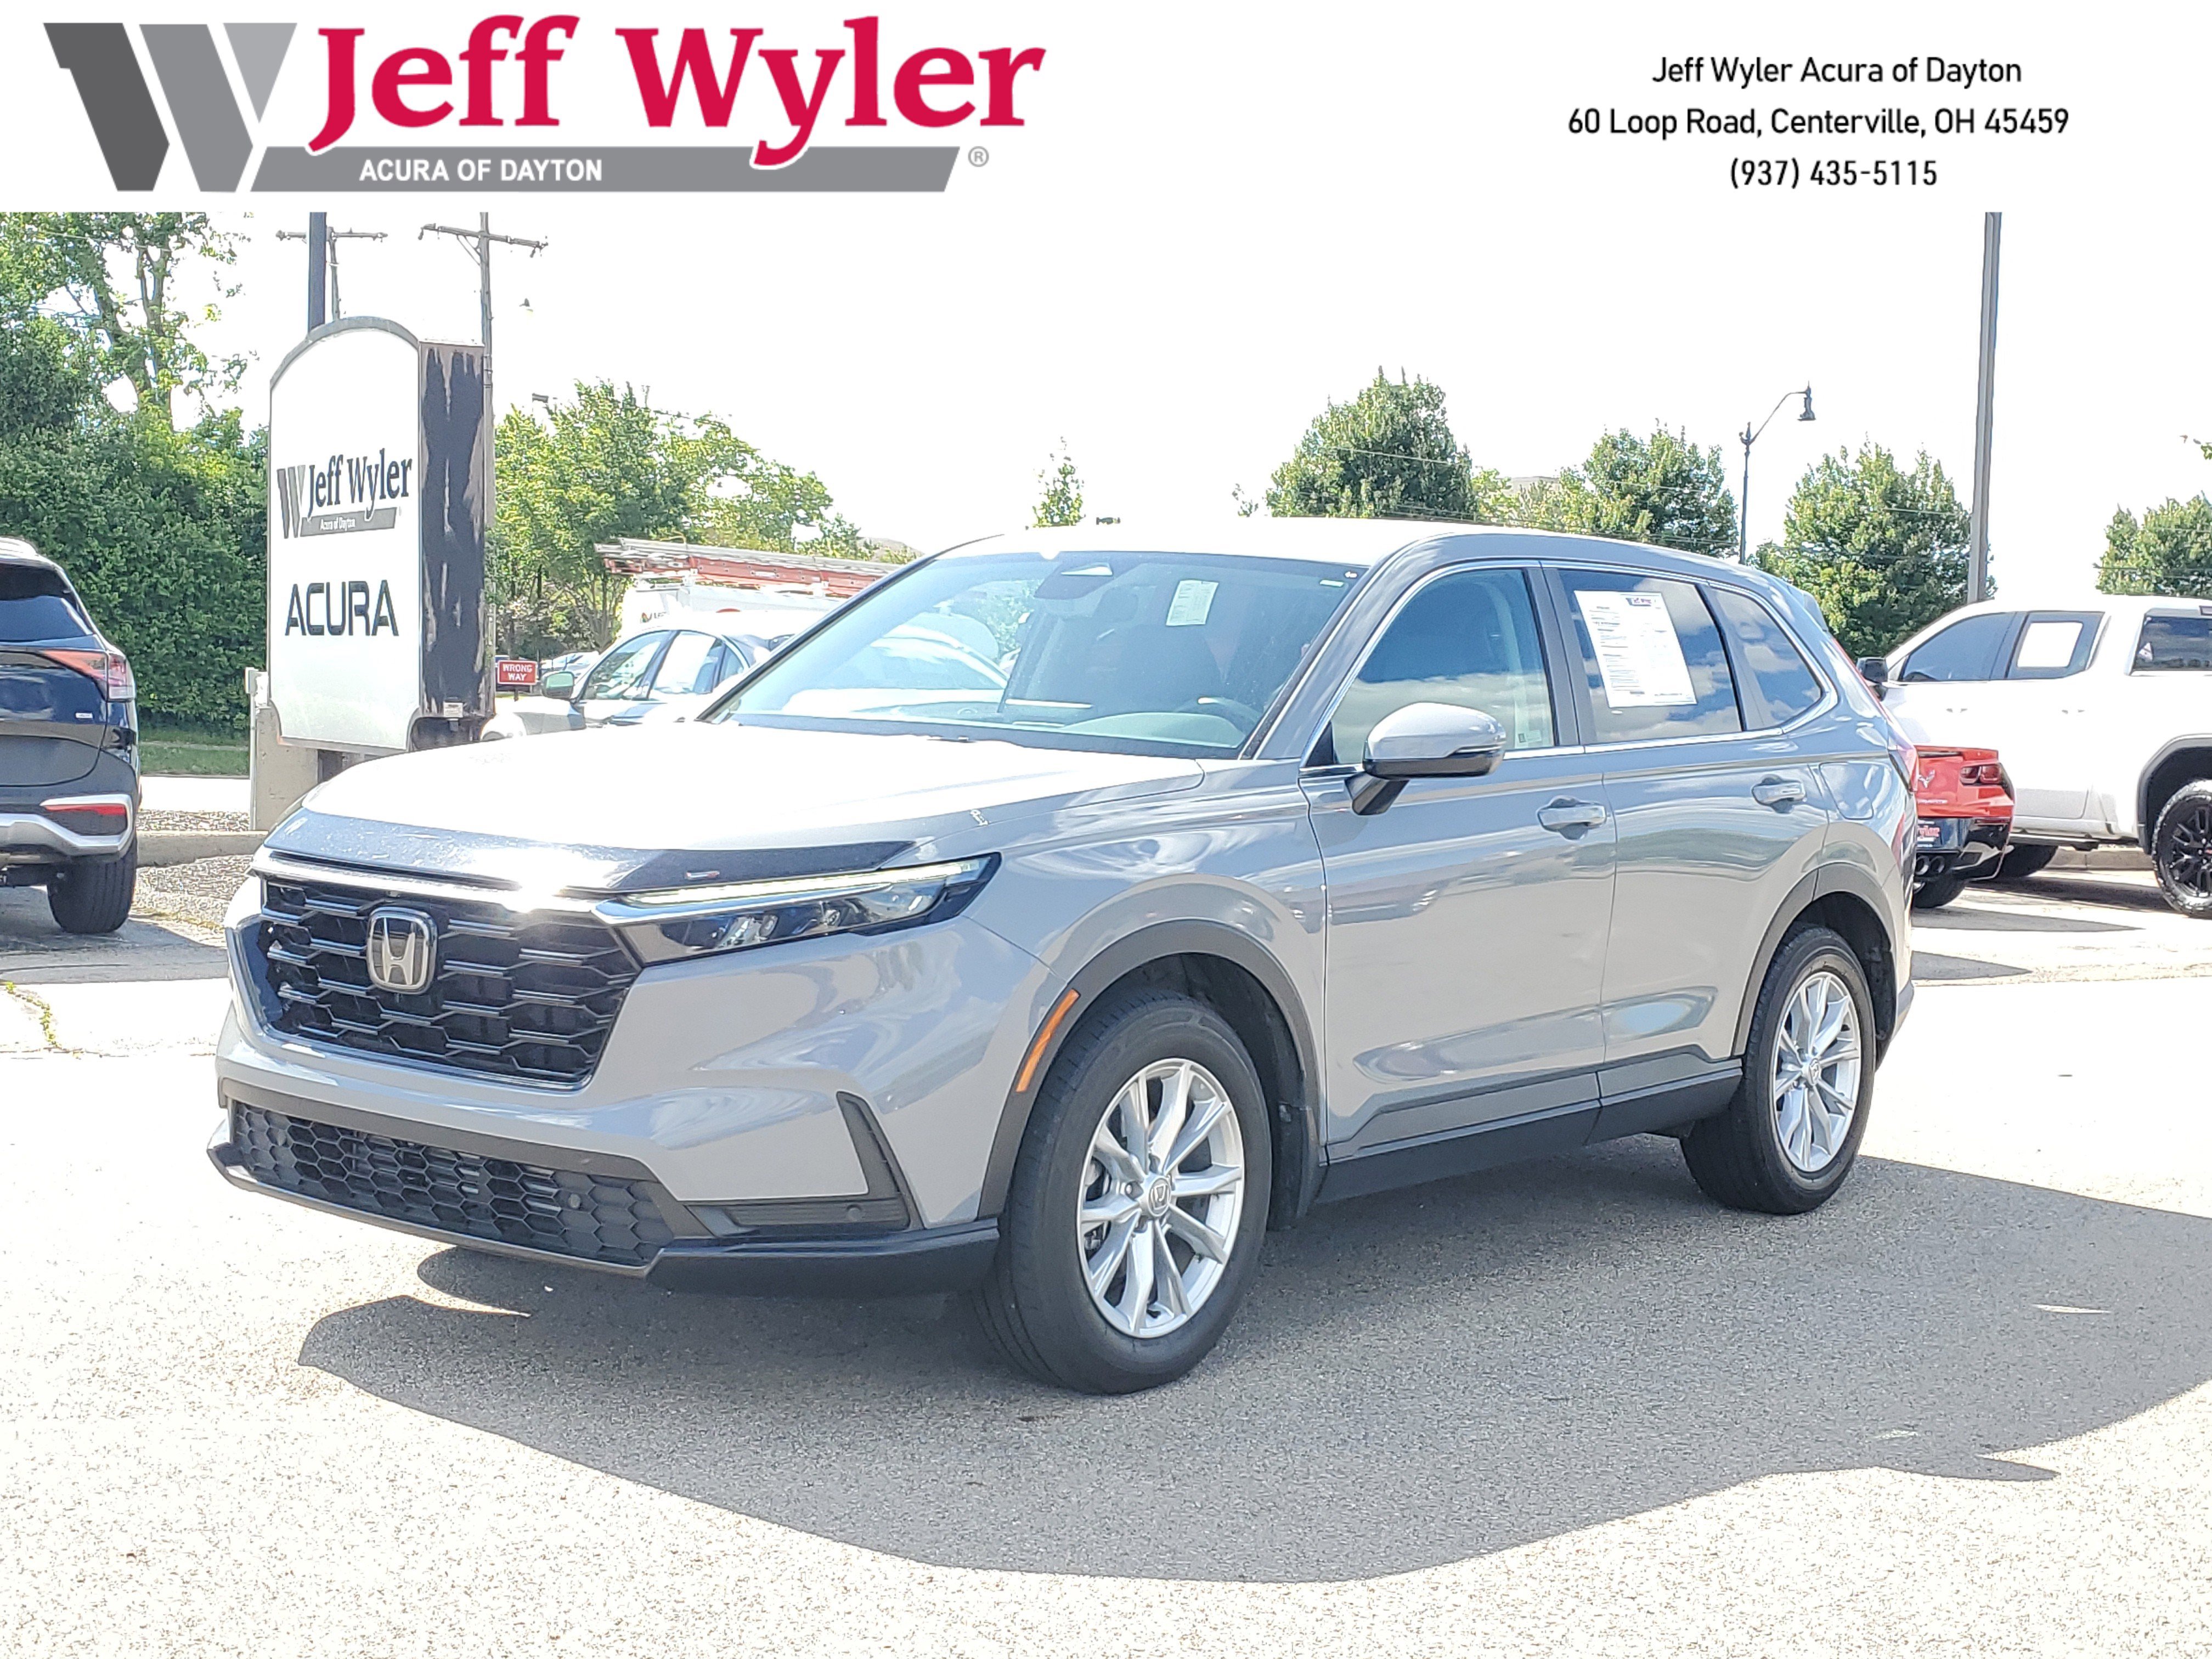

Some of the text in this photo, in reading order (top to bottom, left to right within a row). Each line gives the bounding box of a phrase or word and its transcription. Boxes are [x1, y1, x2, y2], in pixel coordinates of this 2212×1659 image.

[307, 448, 413, 520] Jeff Wyler
[285, 579, 399, 636] ACURA
[503, 663, 533, 673] WRONG
[507, 673, 527, 681] WAY
